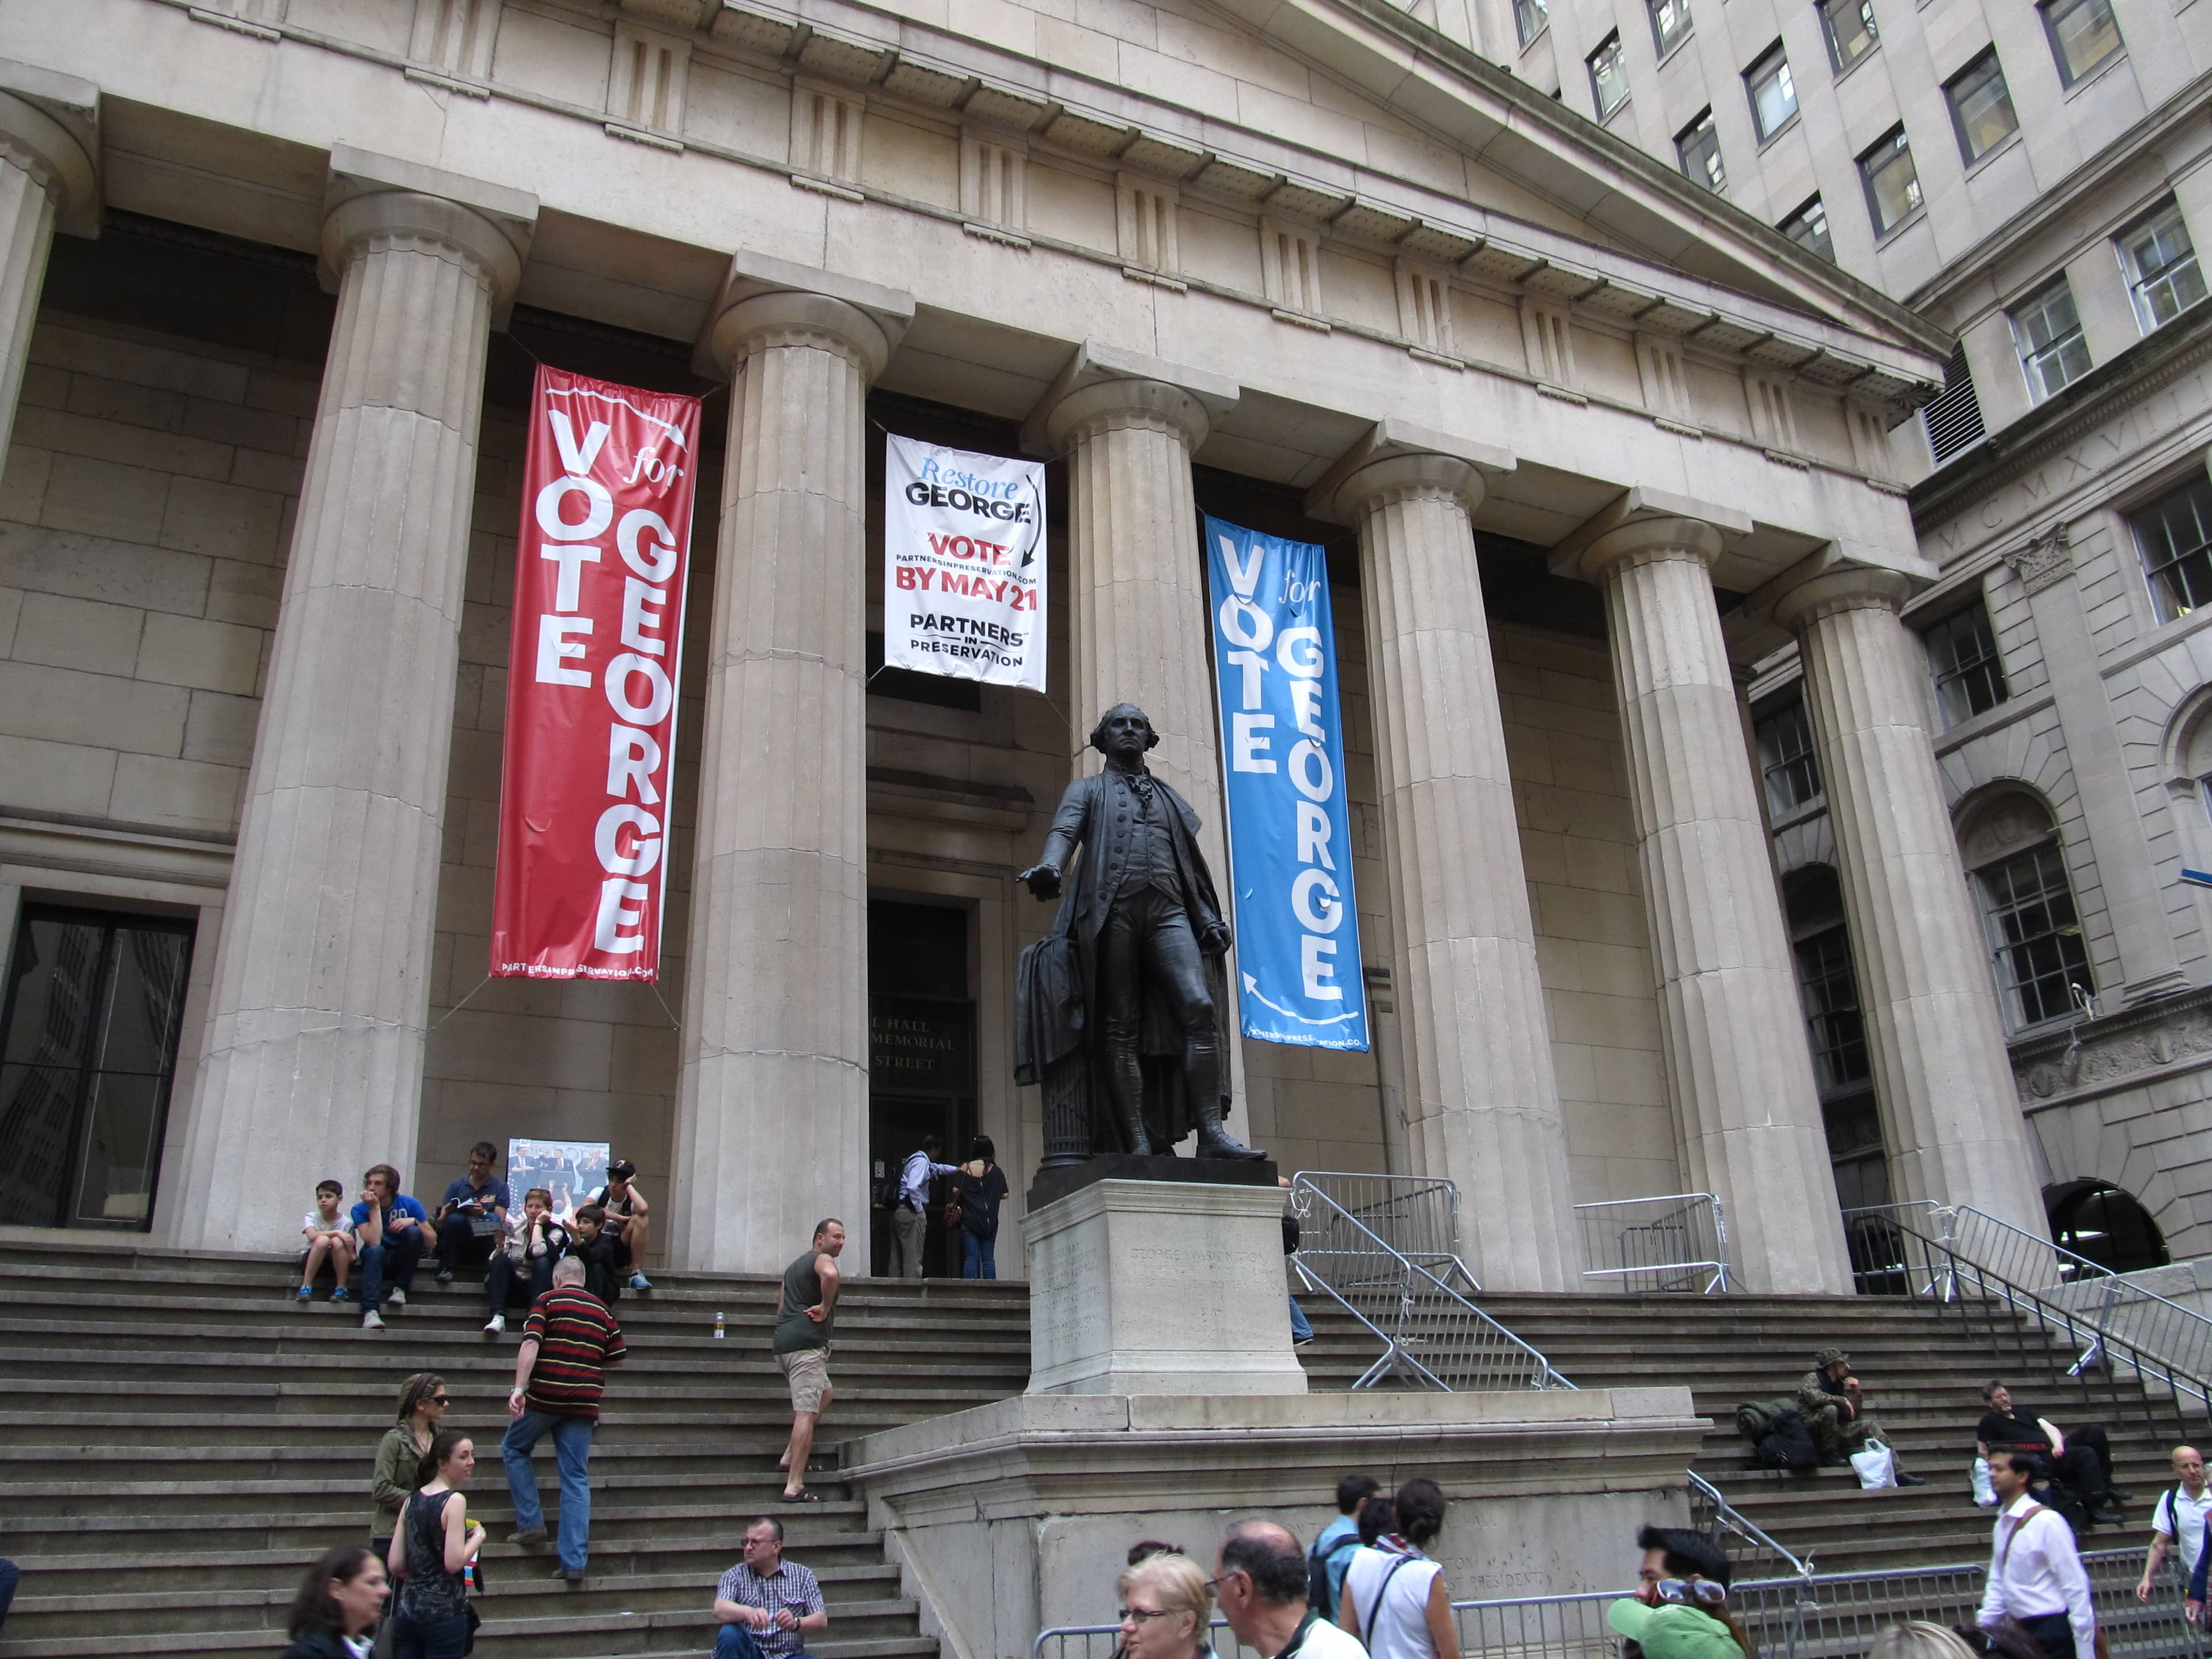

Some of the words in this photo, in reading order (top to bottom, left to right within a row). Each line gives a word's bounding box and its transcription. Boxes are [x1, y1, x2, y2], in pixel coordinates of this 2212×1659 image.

[623, 446, 685, 488] for
[918, 457, 1019, 500] Restore
[905, 482, 1032, 525] GEORGE
[535, 410, 613, 688] VOTE
[927, 532, 1013, 566] VOTE
[896, 554, 1037, 585] PARTNERSINPRESERVATION.COM
[896, 565, 937, 591] BY
[941, 570, 1009, 604] MAY
[1010, 585, 1037, 612] 21
[1278, 569, 1321, 604] for
[910, 639, 1023, 667] PRESERVATION
[964, 635, 978, 645] IN
[1218, 535, 1278, 774] VOTE
[594, 509, 677, 954] GEORGE
[1276, 626, 1344, 1001] GEORGE
[870, 1032, 956, 1050] MEMORIAL
[887, 1018, 931, 1032] HALL
[875, 1055, 935, 1070] STREET
